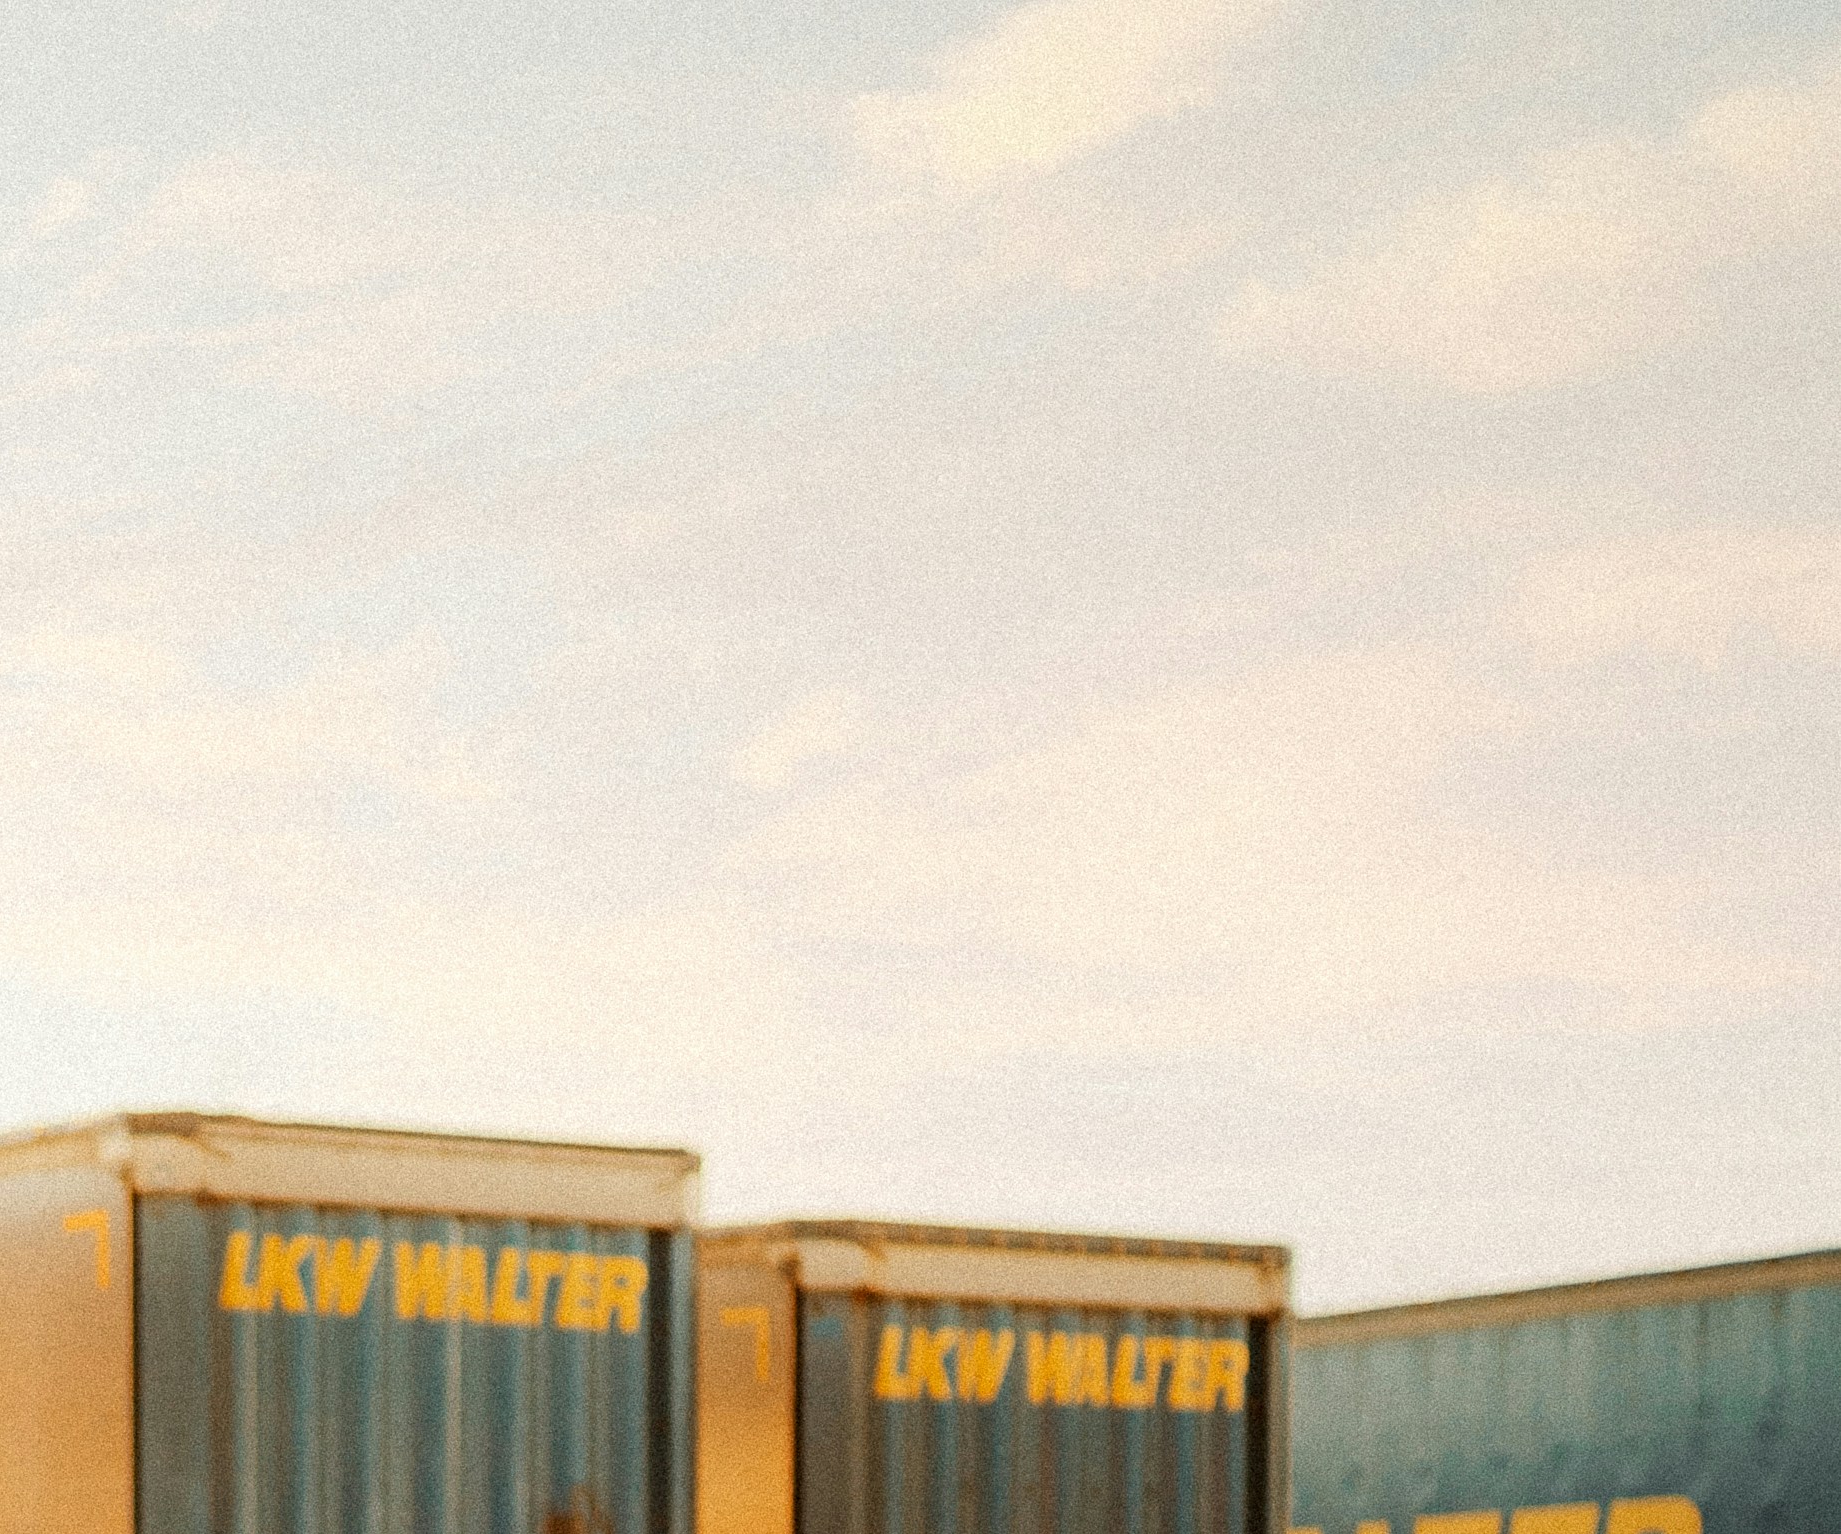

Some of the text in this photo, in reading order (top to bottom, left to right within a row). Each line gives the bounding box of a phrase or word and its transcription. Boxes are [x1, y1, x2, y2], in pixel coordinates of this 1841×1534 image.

[219, 1230, 649, 1335] LKW WALTER
[873, 1324, 1250, 1412] LKW WALTER
